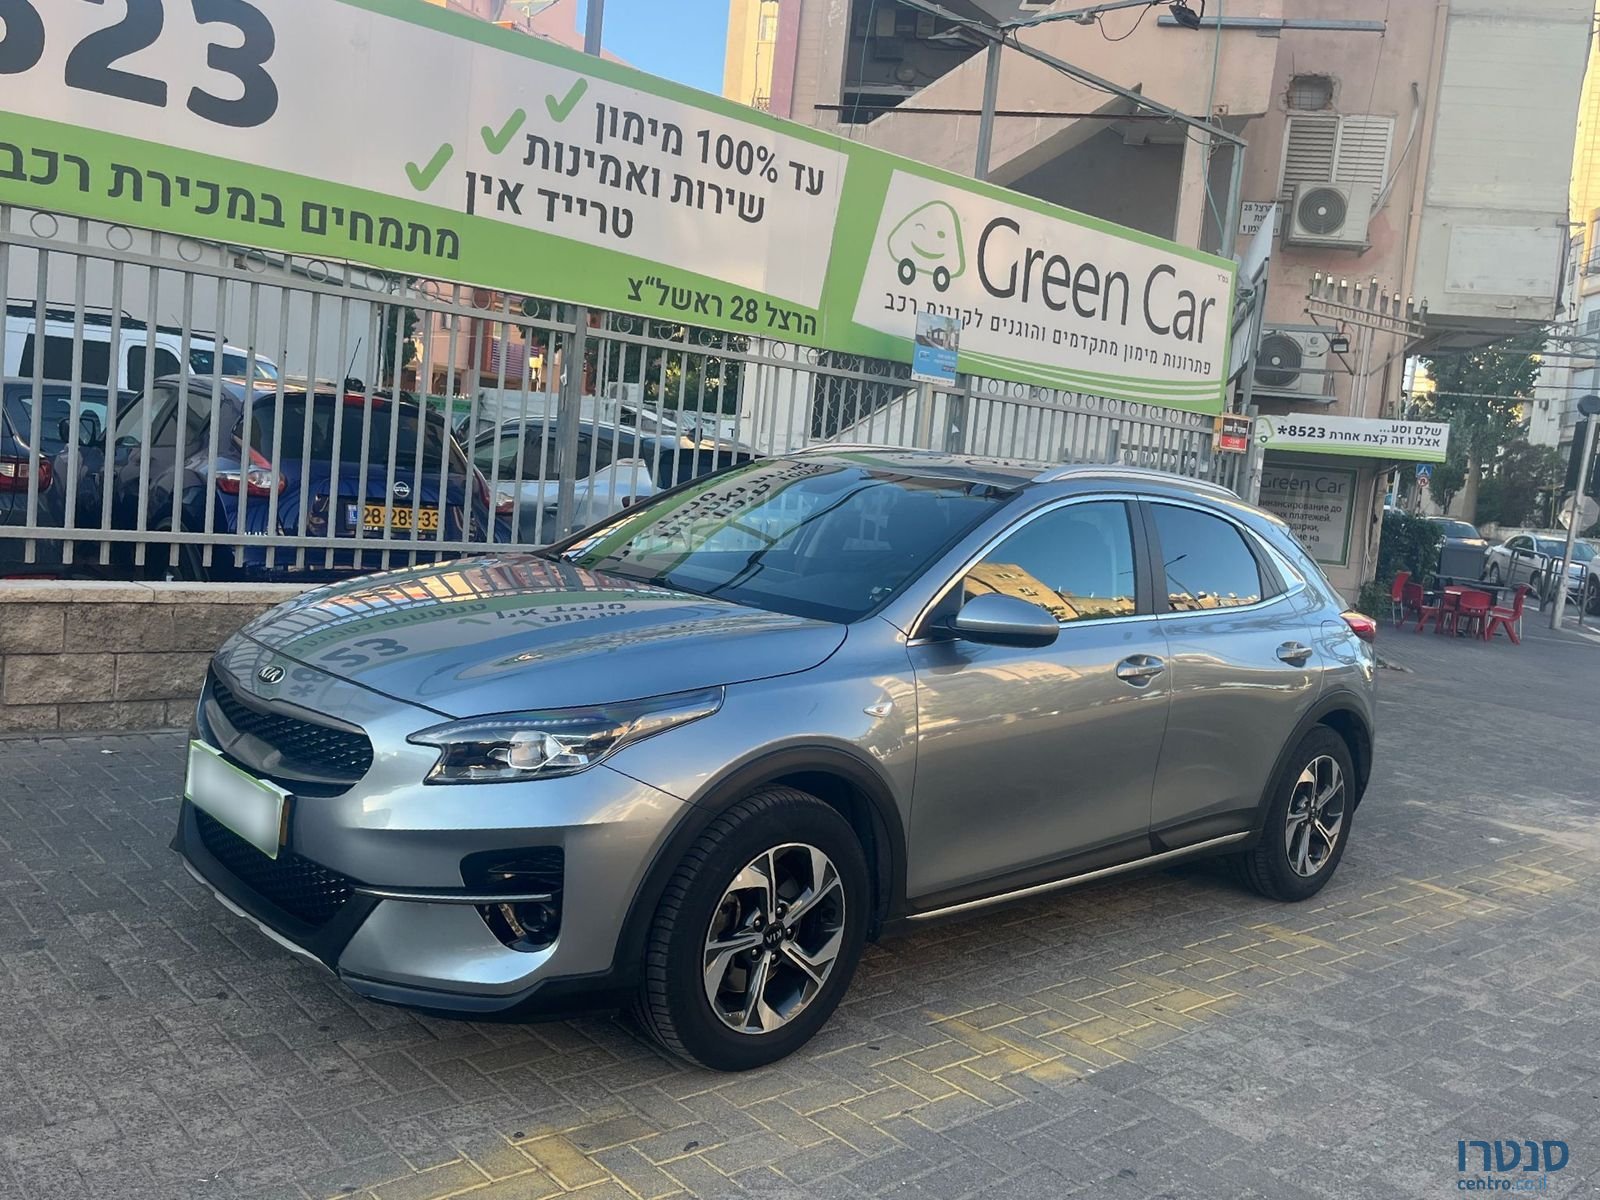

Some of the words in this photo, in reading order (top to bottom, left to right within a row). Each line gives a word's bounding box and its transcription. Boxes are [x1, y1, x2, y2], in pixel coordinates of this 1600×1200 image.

[0, 0, 278, 127] 23
[595, 102, 682, 156] מימון
[0, 142, 90, 192] רכב
[523, 134, 660, 198] ואמינות
[697, 129, 778, 183] 100%
[465, 170, 525, 215] אין
[788, 160, 825, 196] עד
[108, 163, 285, 229] במכירת
[671, 173, 766, 223] שירות
[537, 187, 633, 238] טרייד
[302, 201, 459, 260] מתמחים
[977, 217, 1129, 326] Green
[1144, 264, 1216, 344] Car
[731, 295, 758, 324] 28
[884, 292, 917, 315] רכב
[765, 302, 817, 336] הרצל
[990, 315, 1046, 342] והוגנים
[1053, 330, 1118, 357] מתקדמים
[1123, 344, 1158, 365] מימון
[1163, 352, 1212, 375] פתרונות
[1329, 430, 1360, 441] אחרת
[1364, 433, 1388, 445] קצת
[1380, 424, 1412, 434] וסע...
[1391, 435, 1404, 444] זה
[1407, 435, 1440, 447] אצלנו
[1416, 423, 1442, 436] שלם
[1261, 472, 1310, 491] Green
[1315, 477, 1345, 493] Car
[260, 666, 280, 681] KIA
